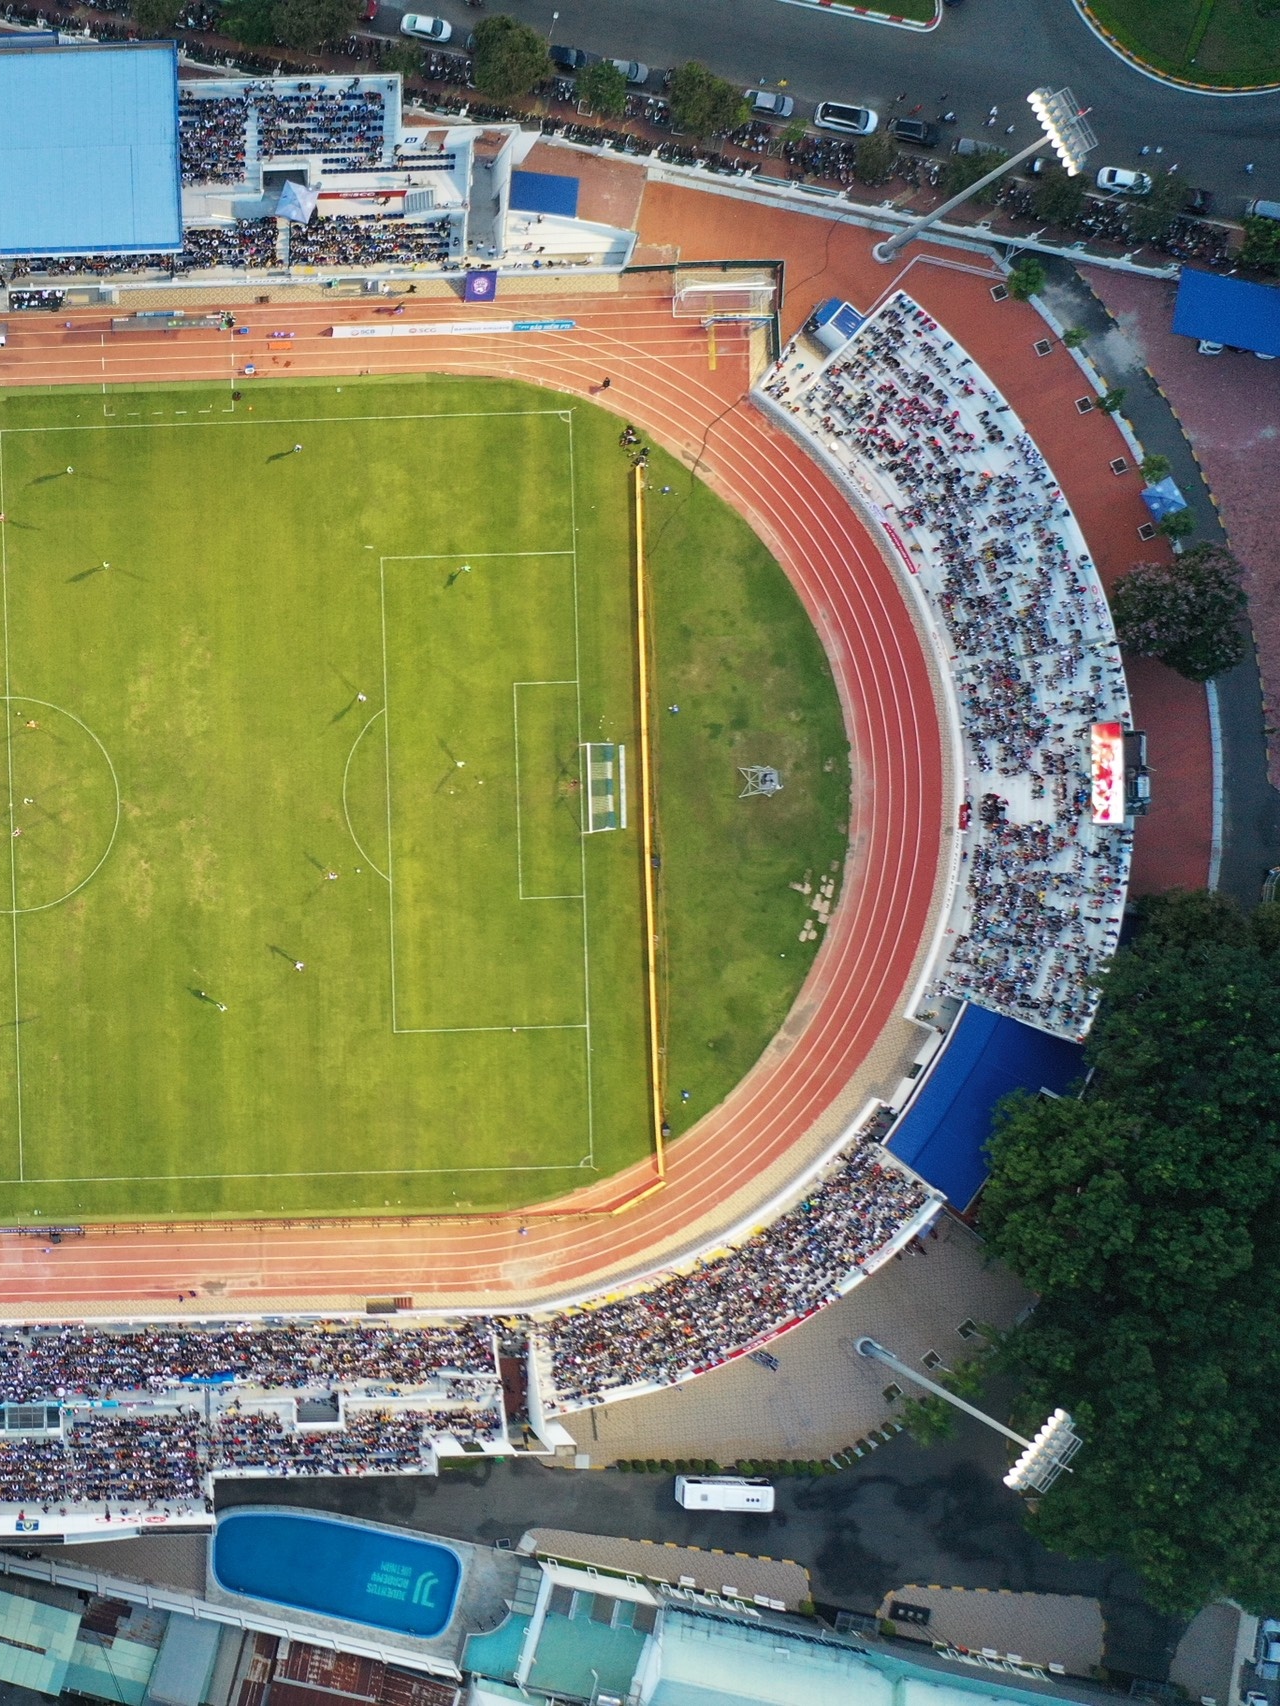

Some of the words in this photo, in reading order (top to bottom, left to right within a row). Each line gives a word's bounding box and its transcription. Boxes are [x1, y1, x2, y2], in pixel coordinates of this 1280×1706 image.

[94, 1516, 138, 1524] SCG
[381, 1561, 412, 1577] VIETNAM
[371, 1572, 409, 1589] ACADEMY
[366, 1583, 408, 1601] JUVENTUS
